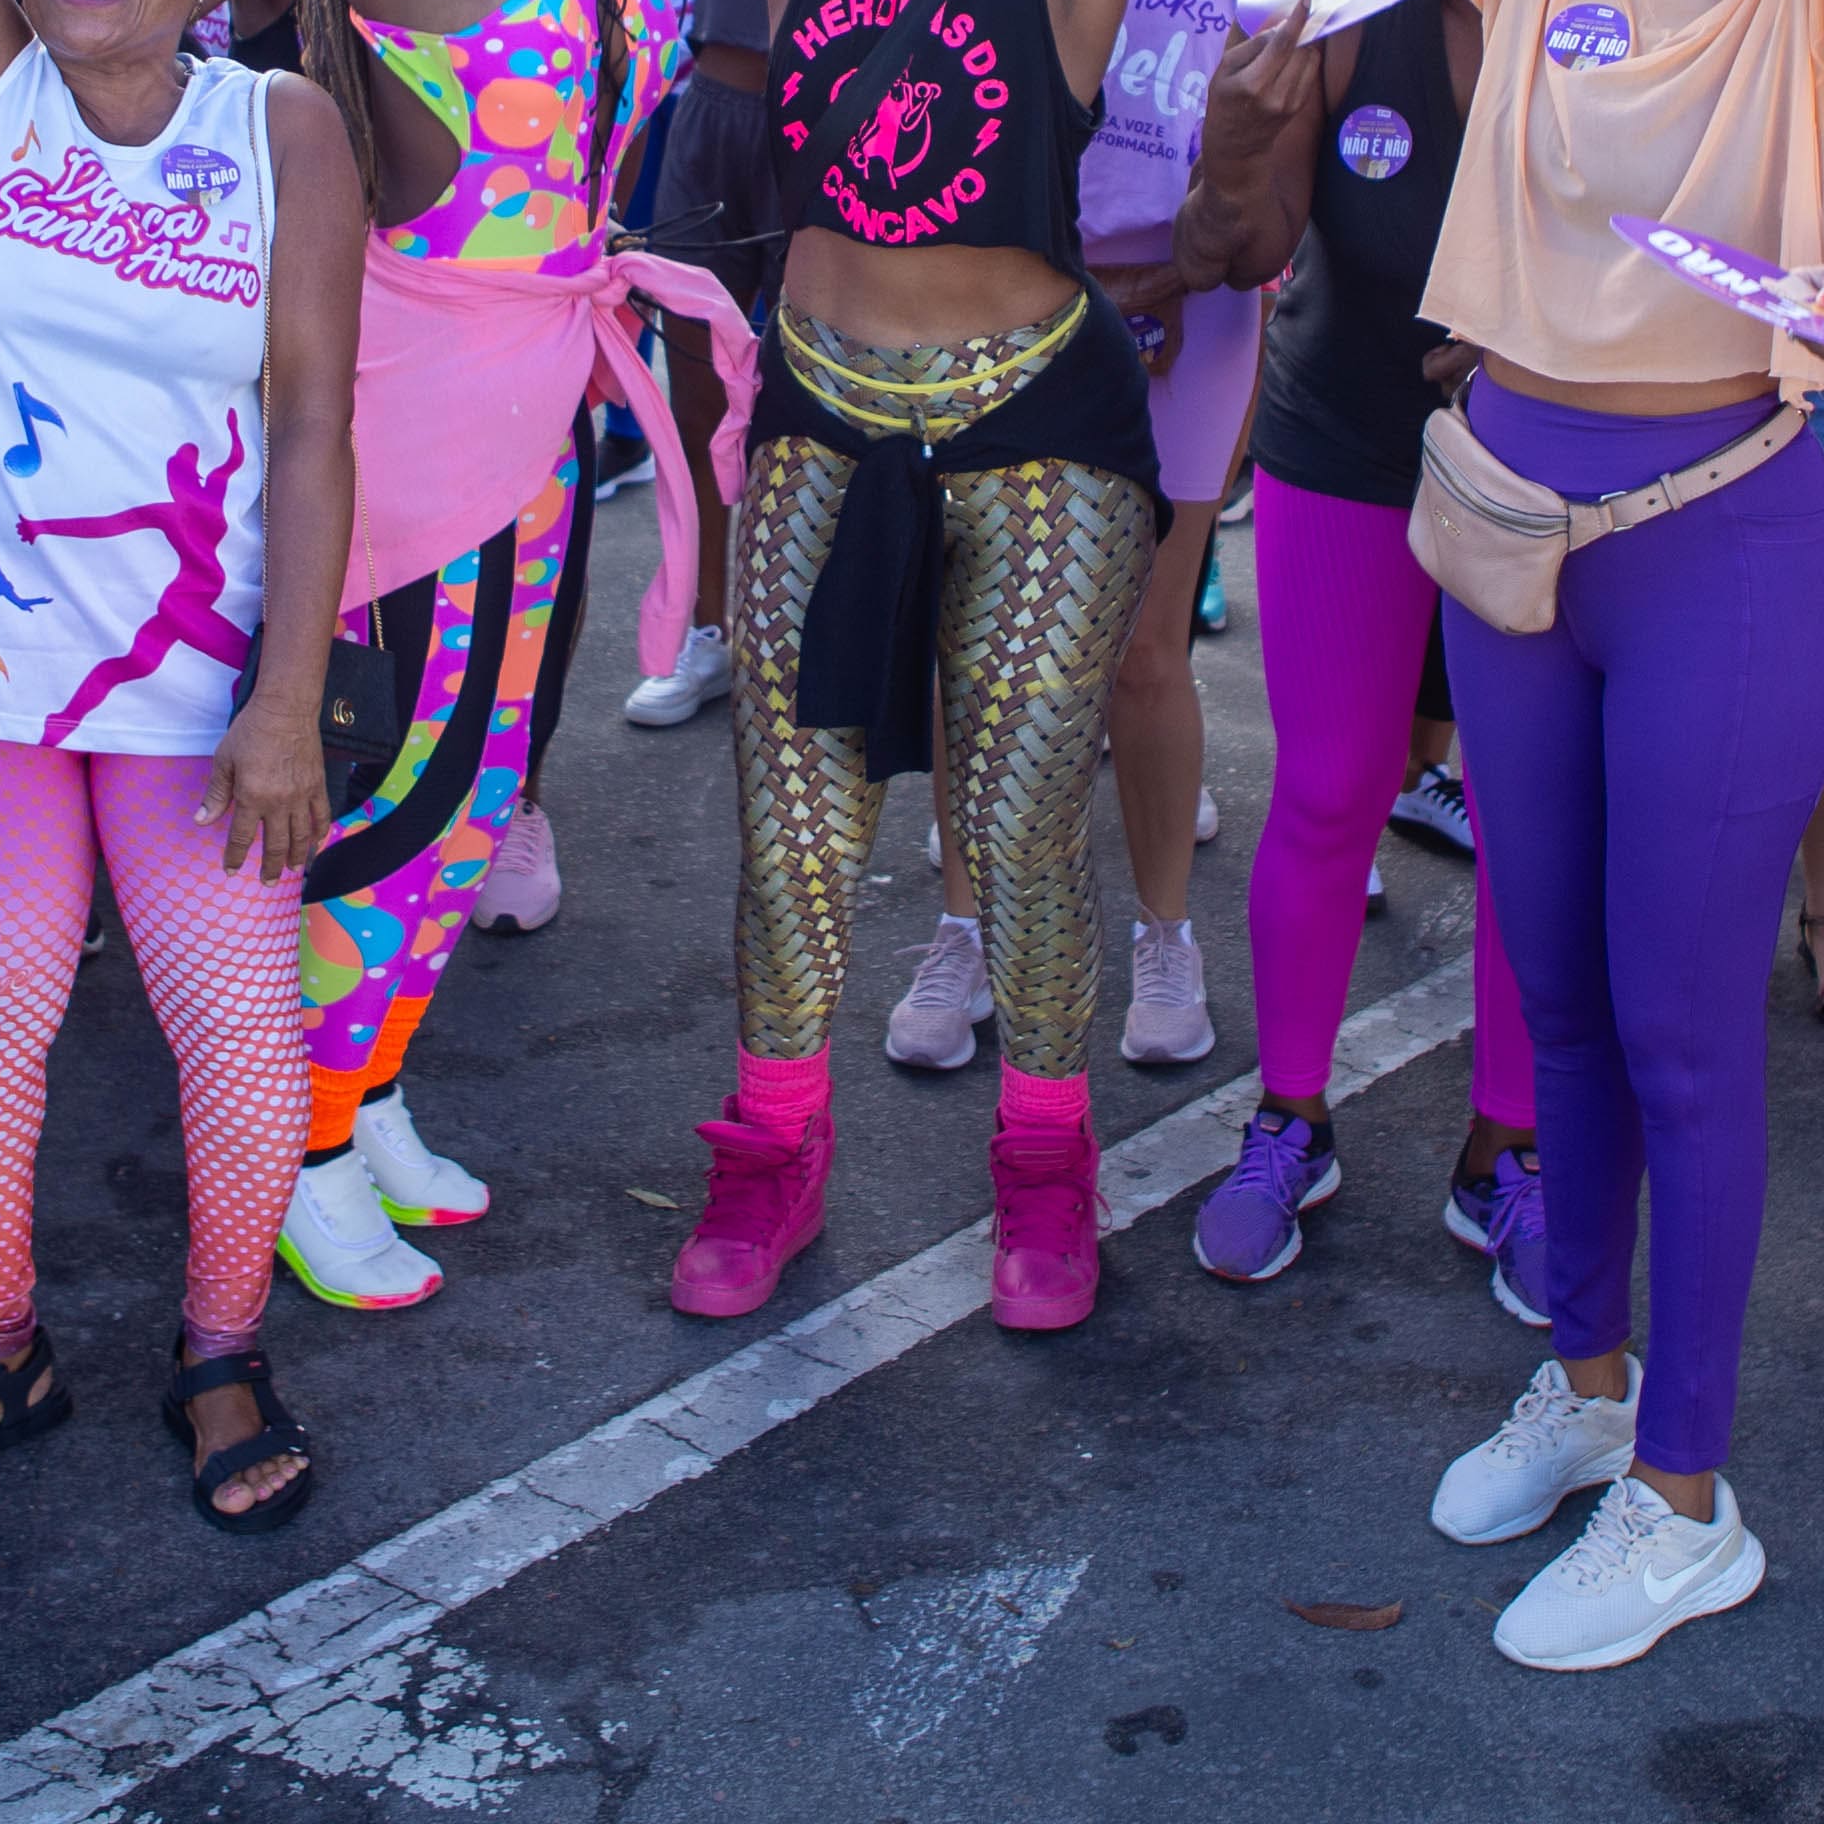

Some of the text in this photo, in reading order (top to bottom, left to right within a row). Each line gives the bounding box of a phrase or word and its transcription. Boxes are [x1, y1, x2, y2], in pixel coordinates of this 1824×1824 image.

[1548, 28, 1628, 56] NÃO É NÃO
[962, 39, 1009, 110] DO
[1125, 117, 1165, 139] VOZ E
[1343, 133, 1409, 157] NÃO É NÃO
[166, 165, 239, 190] NÃO É NÃO
[124, 242, 259, 300] Amaro
